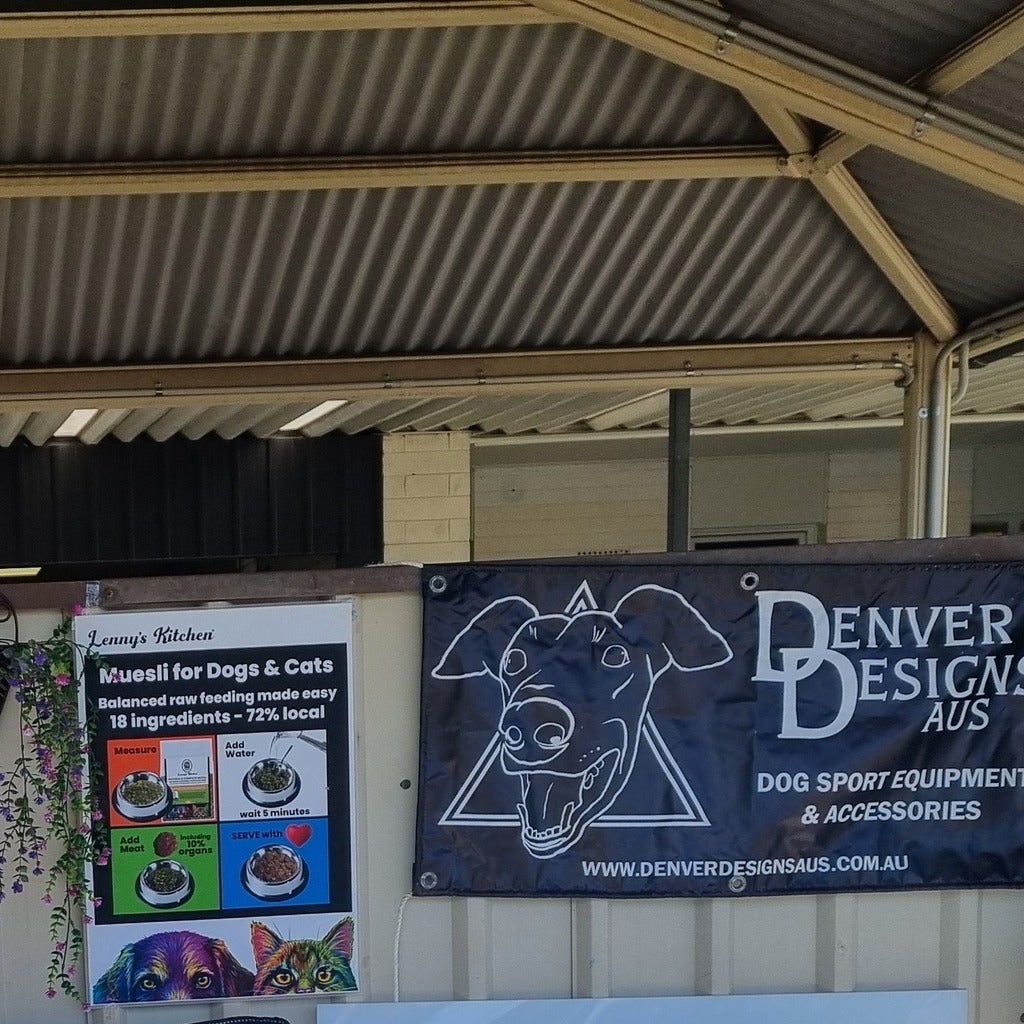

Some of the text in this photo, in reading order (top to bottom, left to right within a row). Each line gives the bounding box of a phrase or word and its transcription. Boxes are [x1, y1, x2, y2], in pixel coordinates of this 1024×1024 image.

[87, 625, 214, 650] Lenny's Kitchen
[751, 590, 1013, 682] DENVER
[99, 657, 334, 684] Muesli for Dogs & Cats
[98, 688, 337, 709] Balanced raw feeding made easy
[110, 714, 128, 729] 18
[130, 709, 231, 731] ingredients
[246, 707, 280, 722] 72%
[283, 704, 325, 720] local
[921, 698, 990, 733] AUS
[114, 746, 157, 755] Measure
[225, 741, 245, 749] Add
[225, 750, 255, 758] Water
[757, 772, 810, 793] DOG
[816, 771, 891, 793] SPORT
[240, 808, 310, 818] wait 5 minutes
[801, 800, 982, 825] & ACCESSORIES
[120, 836, 140, 844] Add
[232, 830, 283, 839] SERVE with
[120, 844, 145, 853] Meat
[187, 840, 205, 848] 10%
[179, 848, 212, 857] organs
[581, 855, 909, 877] WWW.DENVERDESIGNSAUS.COM.AU
